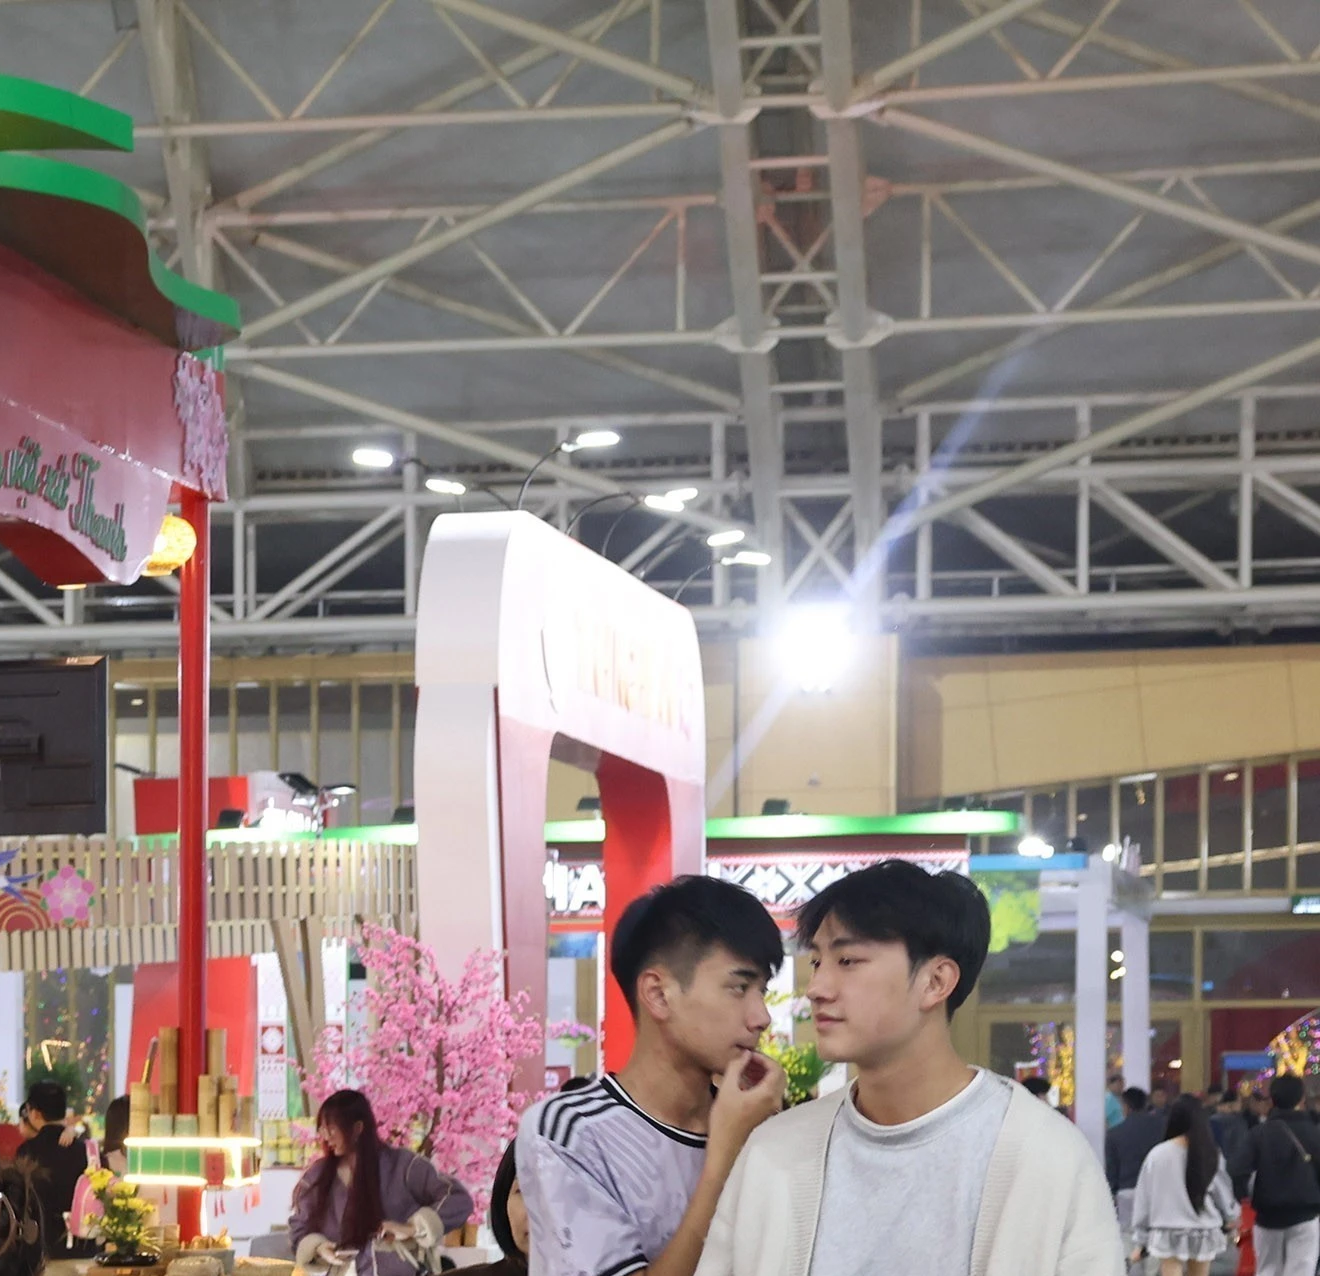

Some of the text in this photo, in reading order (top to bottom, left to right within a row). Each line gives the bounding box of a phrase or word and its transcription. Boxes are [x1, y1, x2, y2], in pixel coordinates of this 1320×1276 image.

[3, 436, 42, 509] vật
[38, 453, 71, 511] xứ
[68, 453, 128, 562] Thanh
